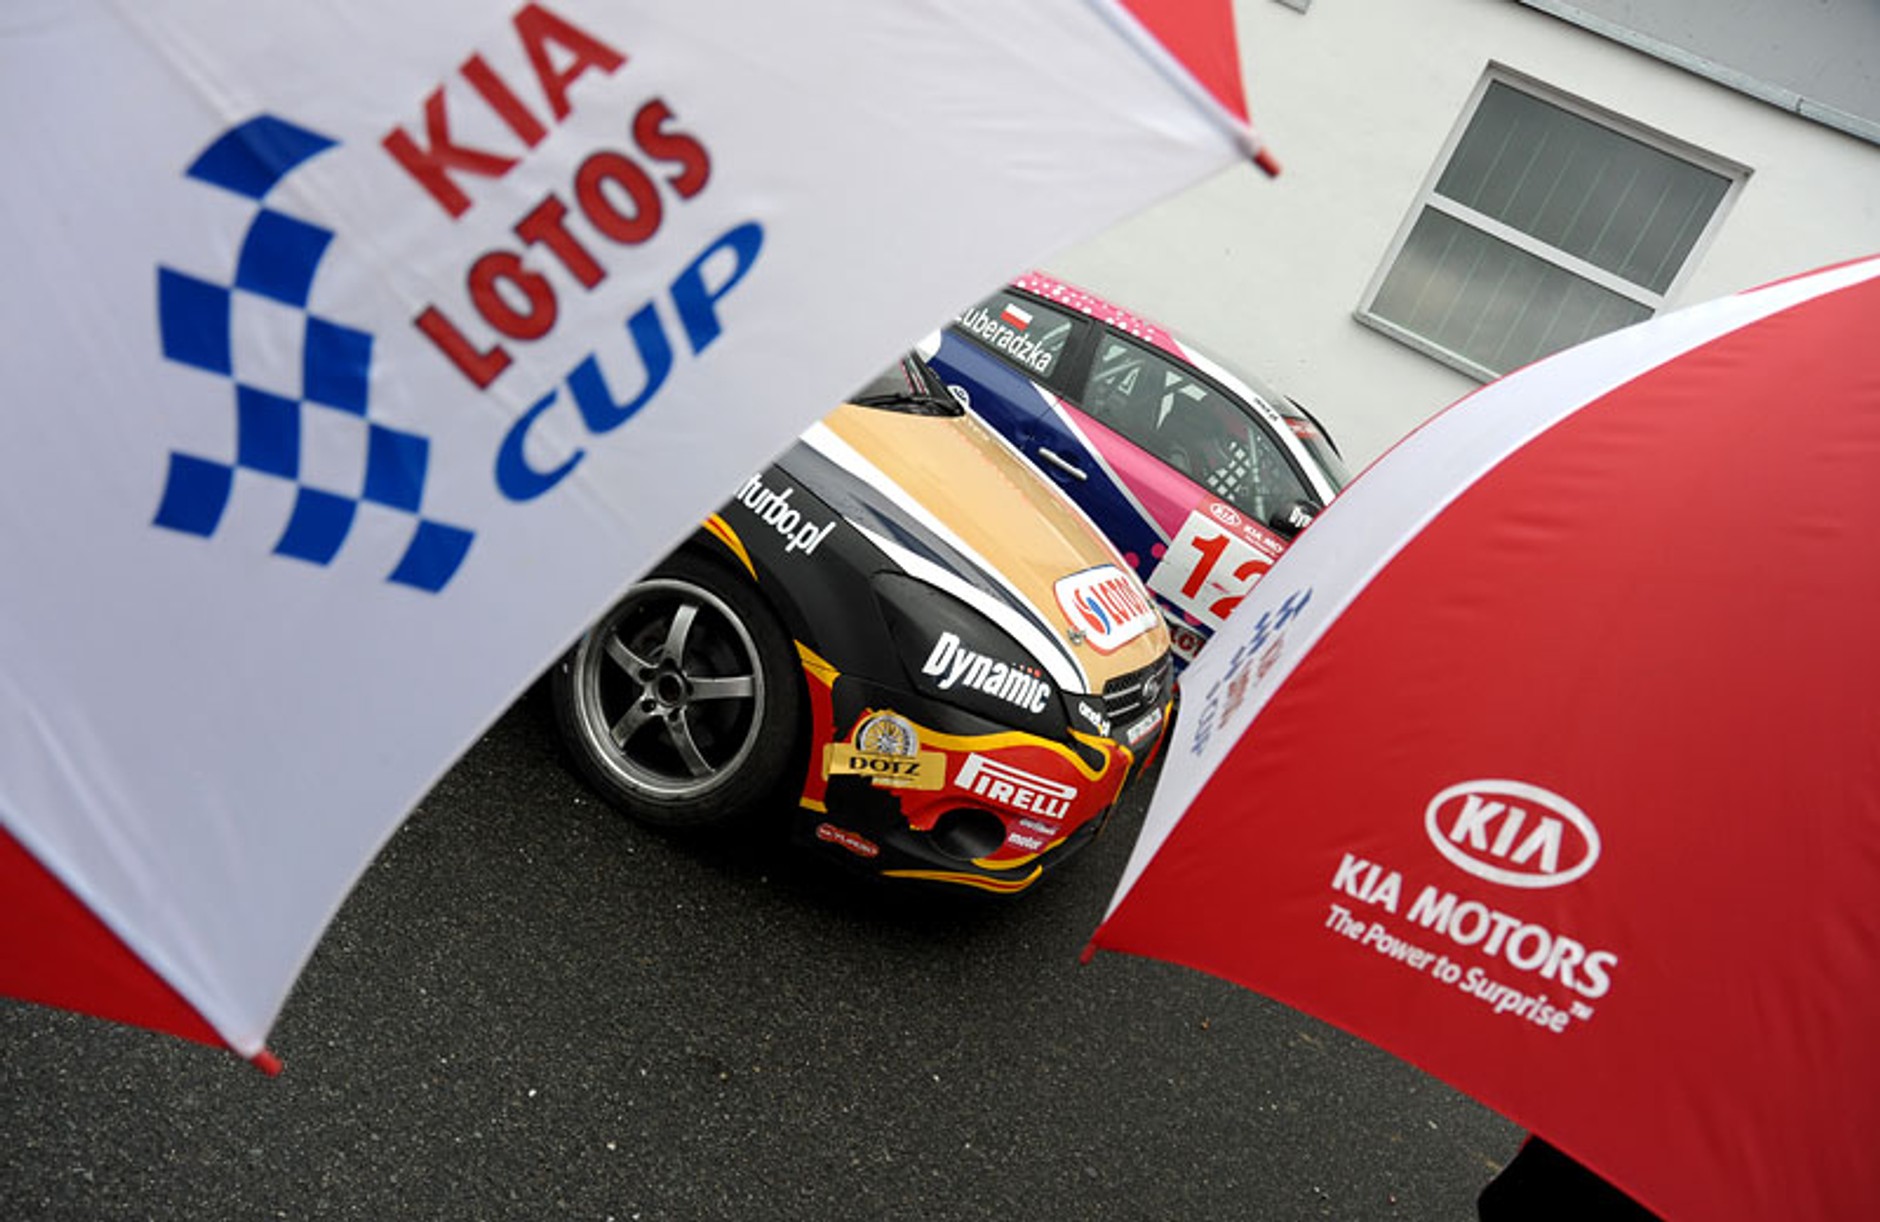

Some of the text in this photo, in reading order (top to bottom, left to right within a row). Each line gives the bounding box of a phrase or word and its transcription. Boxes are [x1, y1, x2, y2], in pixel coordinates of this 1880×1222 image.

[380, 0, 629, 220] KIA
[413, 96, 712, 391] LOTOS
[494, 220, 764, 503] CUP
[956, 308, 1053, 373] uberadzka
[921, 631, 1050, 714] Dynamic
[849, 756, 921, 776] DOTZ
[954, 752, 1077, 820] PIRELLI
[1449, 793, 1563, 874] KIA
[1325, 903, 1362, 939] The
[1361, 923, 1436, 971] Power
[1432, 955, 1461, 983] to
[1331, 853, 1618, 998] KIA MOTORS
